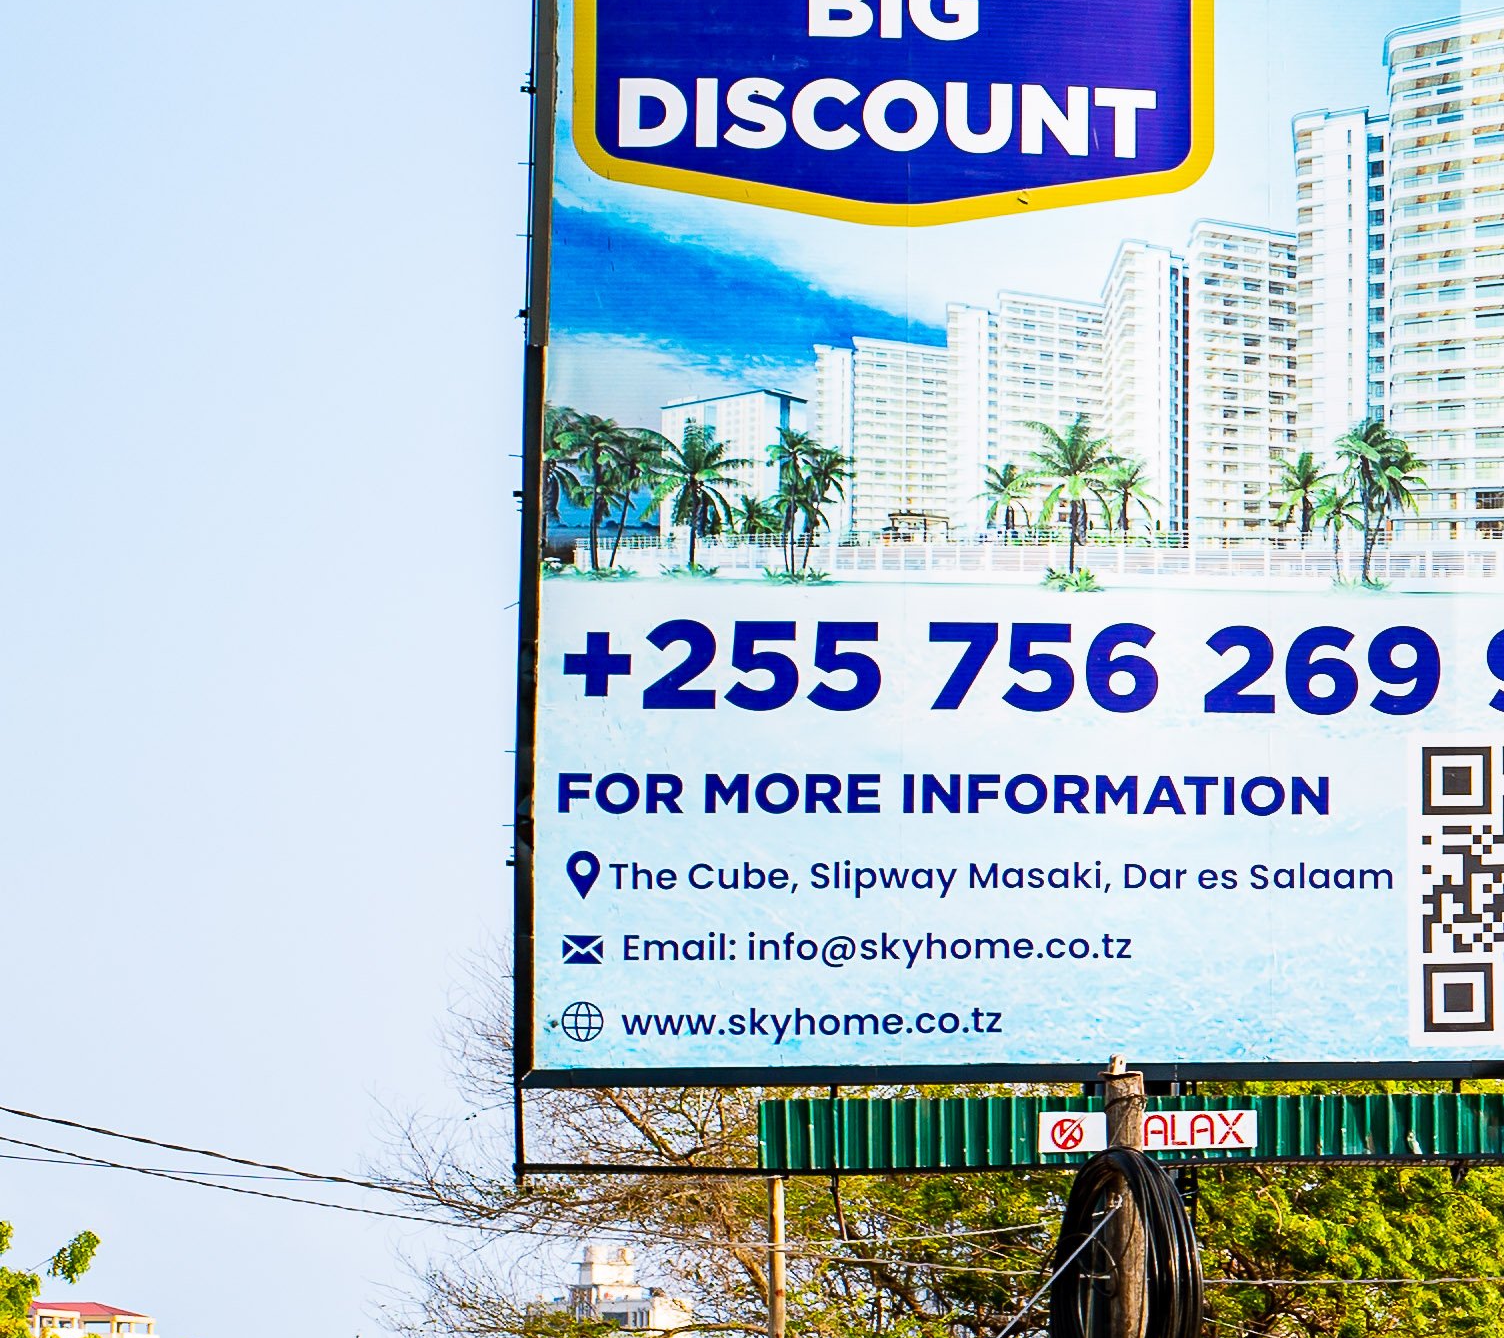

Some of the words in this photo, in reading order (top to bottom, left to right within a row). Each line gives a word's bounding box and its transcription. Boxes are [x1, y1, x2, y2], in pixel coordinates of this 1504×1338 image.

[617, 76, 1158, 160] DISCOUNT
[562, 617, 884, 713] +255
[927, 620, 1160, 714] 756
[1203, 623, 1442, 716] 269
[557, 771, 685, 815] FOR
[704, 772, 881, 815] MORE
[902, 773, 1331, 817] INFORMATION
[608, 861, 678, 892] The
[687, 860, 799, 896] Cube,
[810, 860, 957, 899] Slipway
[968, 860, 1112, 896] Masaki,
[1122, 862, 1187, 891] Dar
[1198, 869, 1240, 892] es
[1249, 861, 1395, 892] Salaam
[621, 932, 737, 963] Email:
[747, 931, 1133, 970] info@skyhome.co.tz
[621, 1004, 1003, 1045] www.skyhome.co.tz
[1143, 1113, 1245, 1146] ALAX
